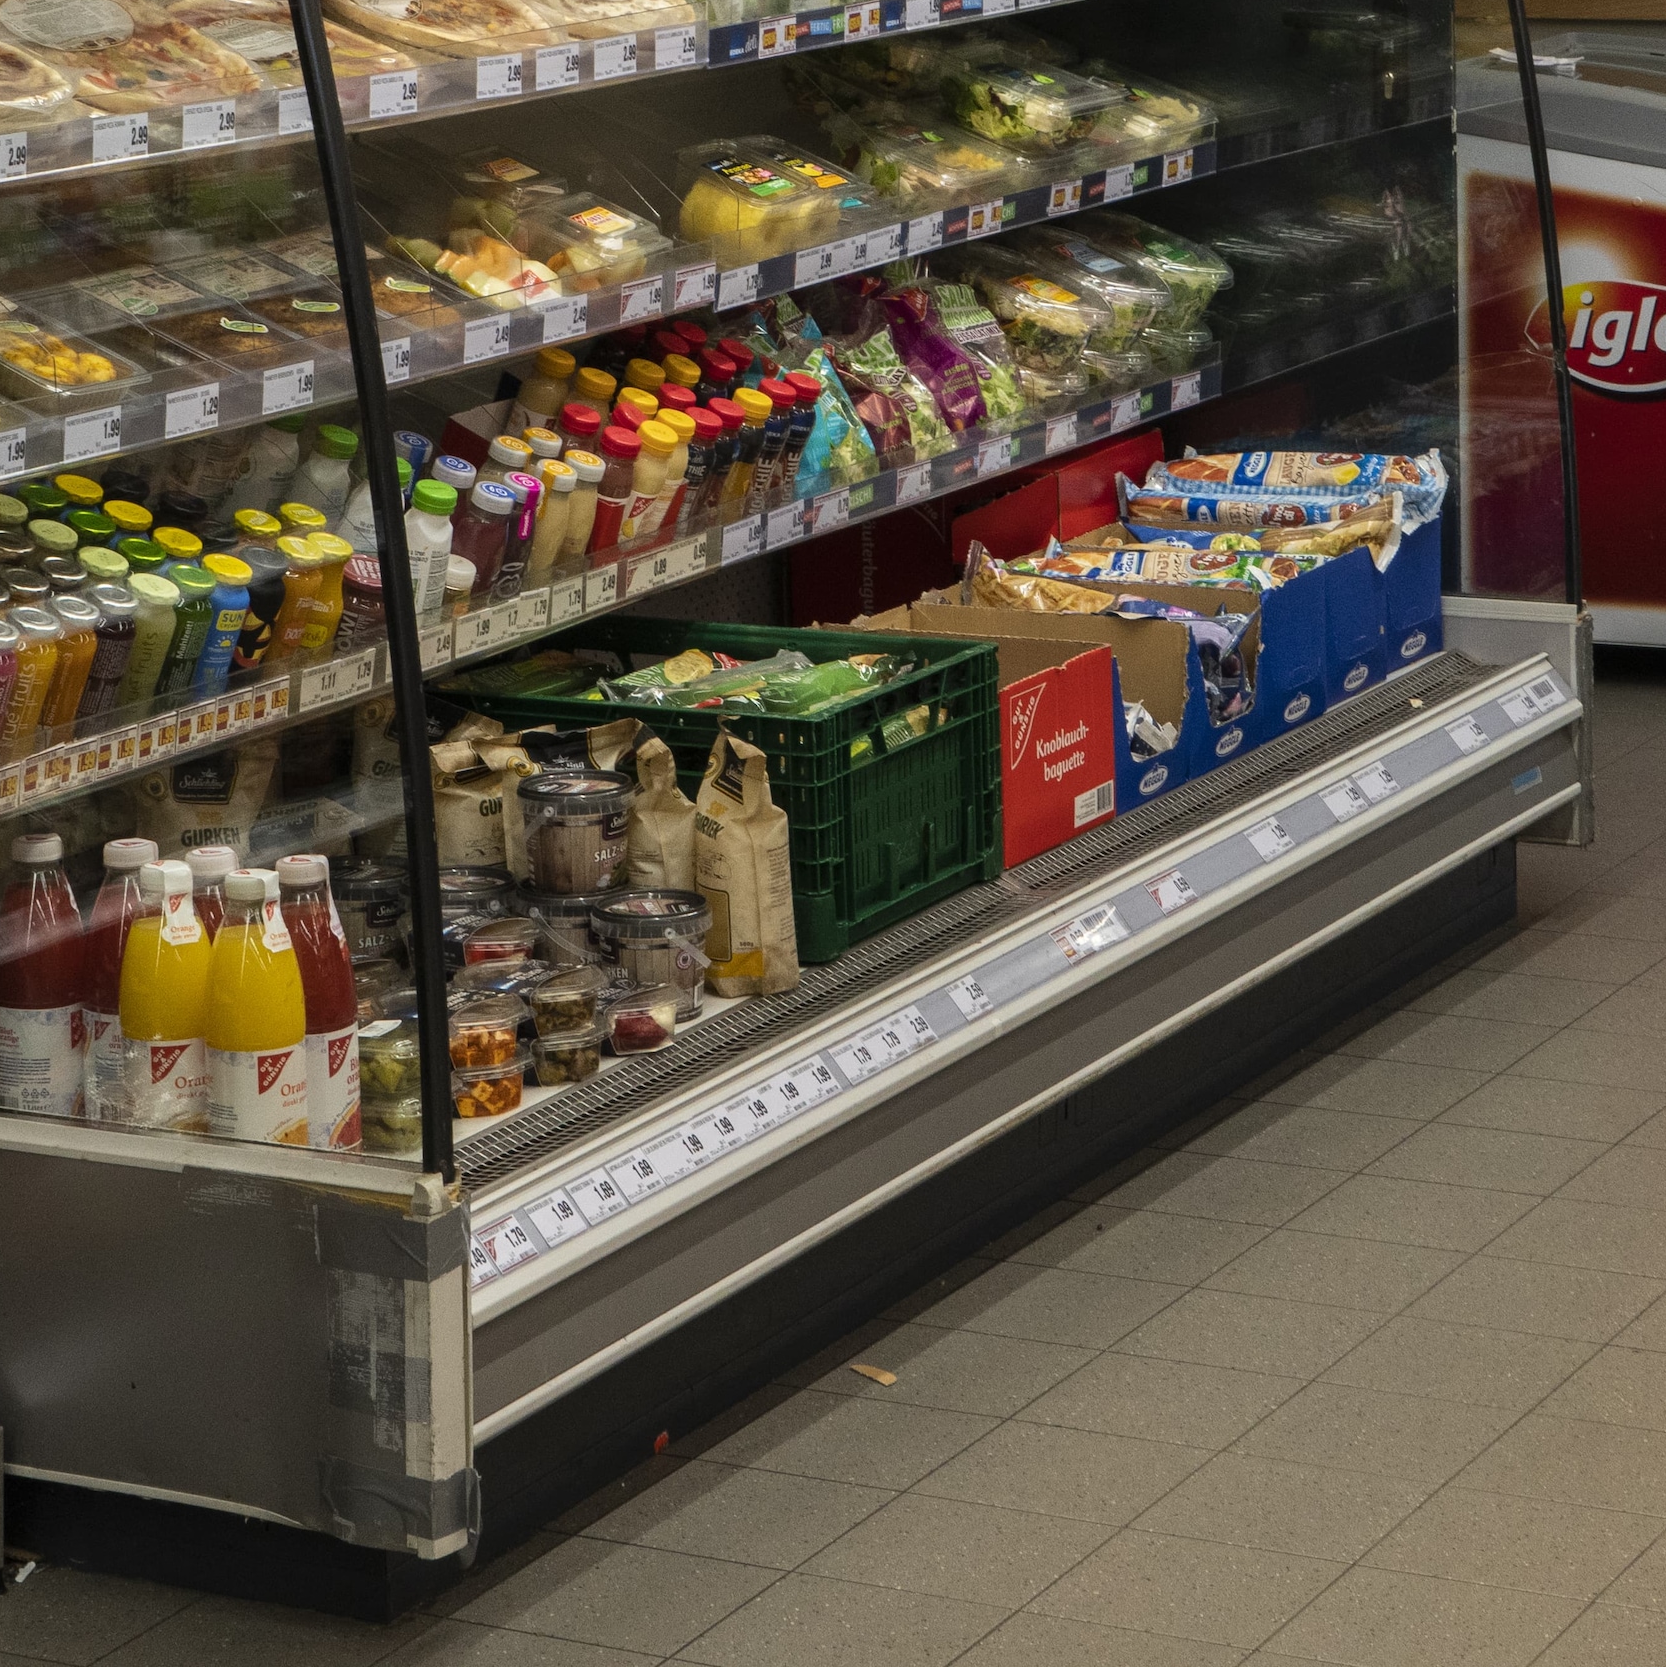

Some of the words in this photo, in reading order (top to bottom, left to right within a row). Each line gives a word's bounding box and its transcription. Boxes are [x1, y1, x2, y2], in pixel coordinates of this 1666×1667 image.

[507, 64, 522, 82] 2.99
[7, 438, 26, 463] 1.99
[1035, 722, 1090, 760] Knoblauch-
[1044, 748, 1086, 783] baguette
[1142, 769, 1165, 793] MEGGLE
[181, 827, 241, 847] GURKEN
[632, 1159, 654, 1180] 1.69
[550, 1199, 575, 1223] 1.99
